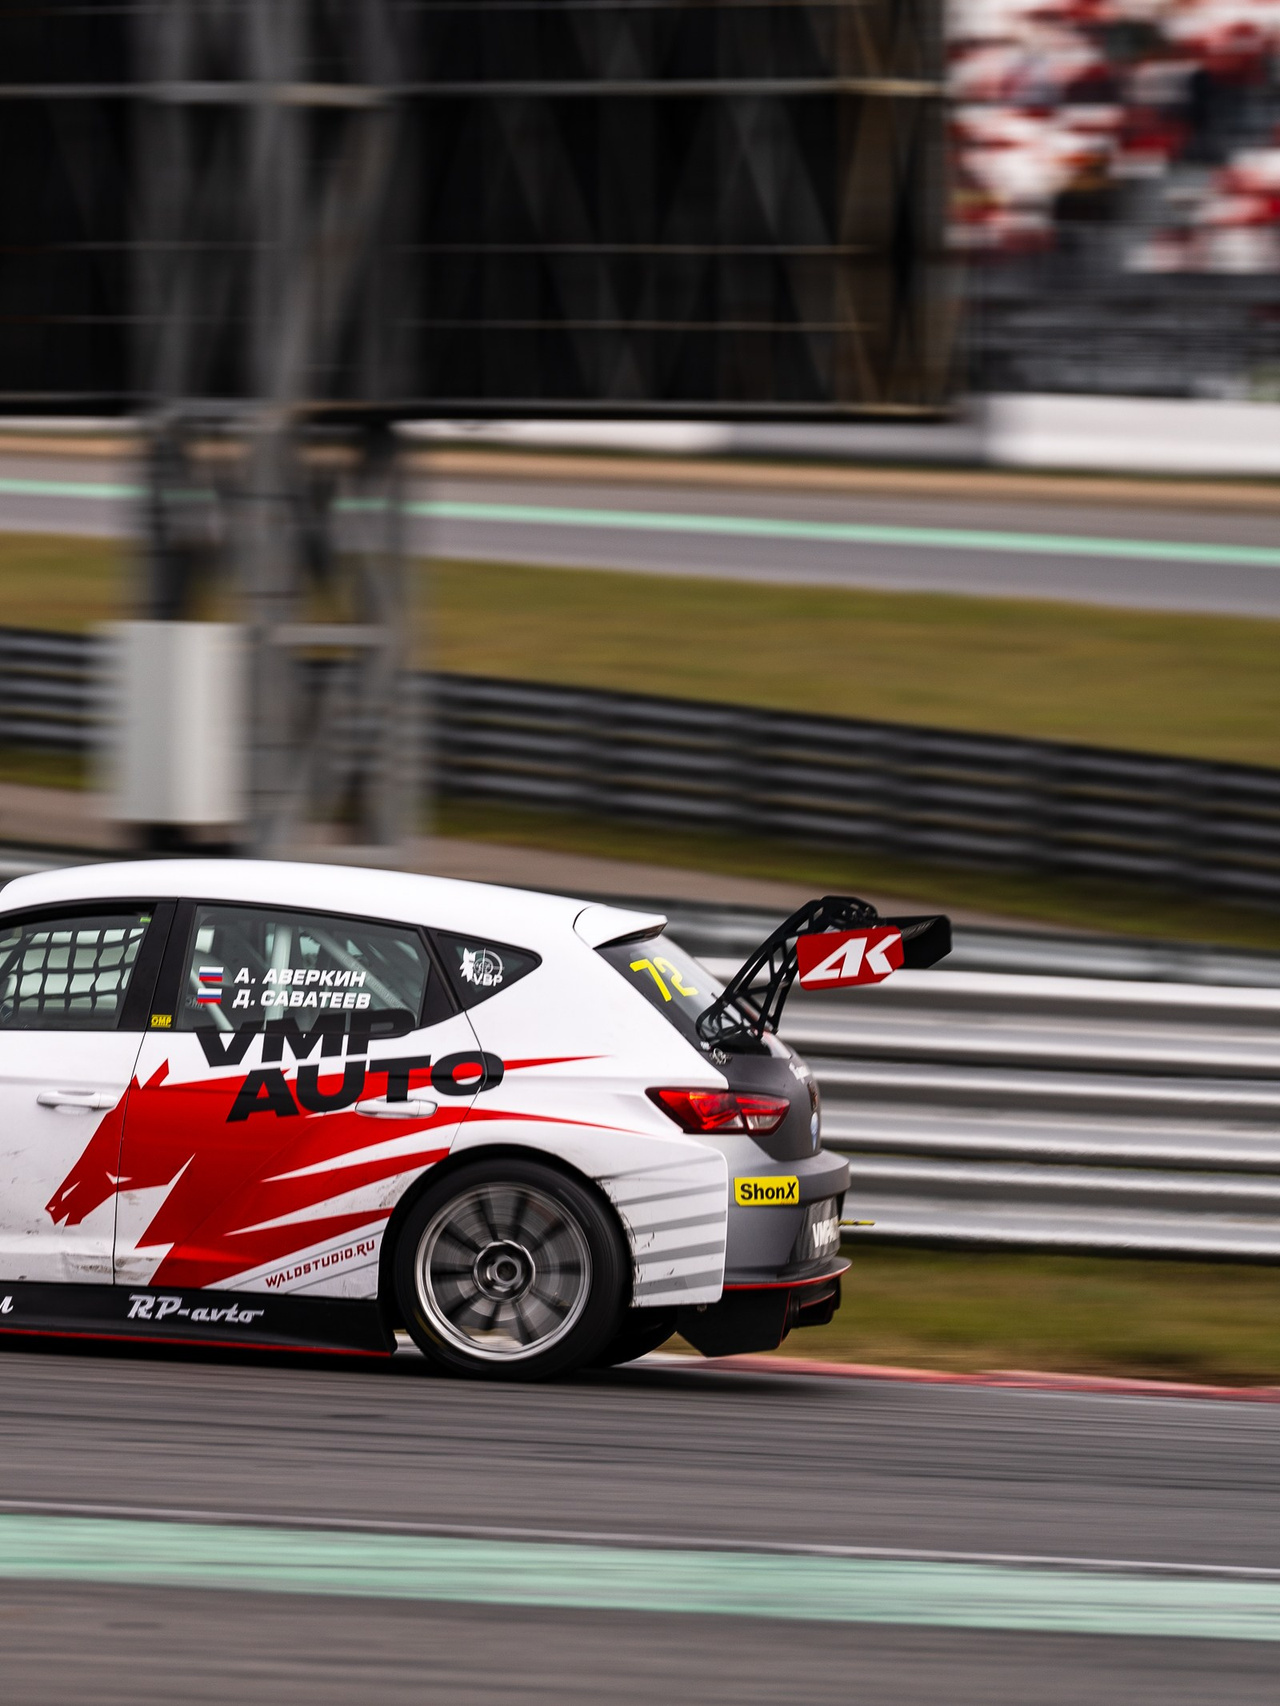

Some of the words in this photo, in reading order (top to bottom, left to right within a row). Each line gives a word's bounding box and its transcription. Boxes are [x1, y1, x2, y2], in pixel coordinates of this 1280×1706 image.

[233, 967, 256, 984] А.
[261, 968, 367, 987] АВЕРКИН
[629, 957, 700, 1002] 72
[232, 989, 255, 1008] Д.
[260, 991, 371, 1009] САВАТЕЕВ
[151, 1016, 172, 1026] OMP
[194, 1009, 416, 1067] VMP
[225, 1051, 504, 1123] AUTO
[740, 1182, 797, 1201] ShonX
